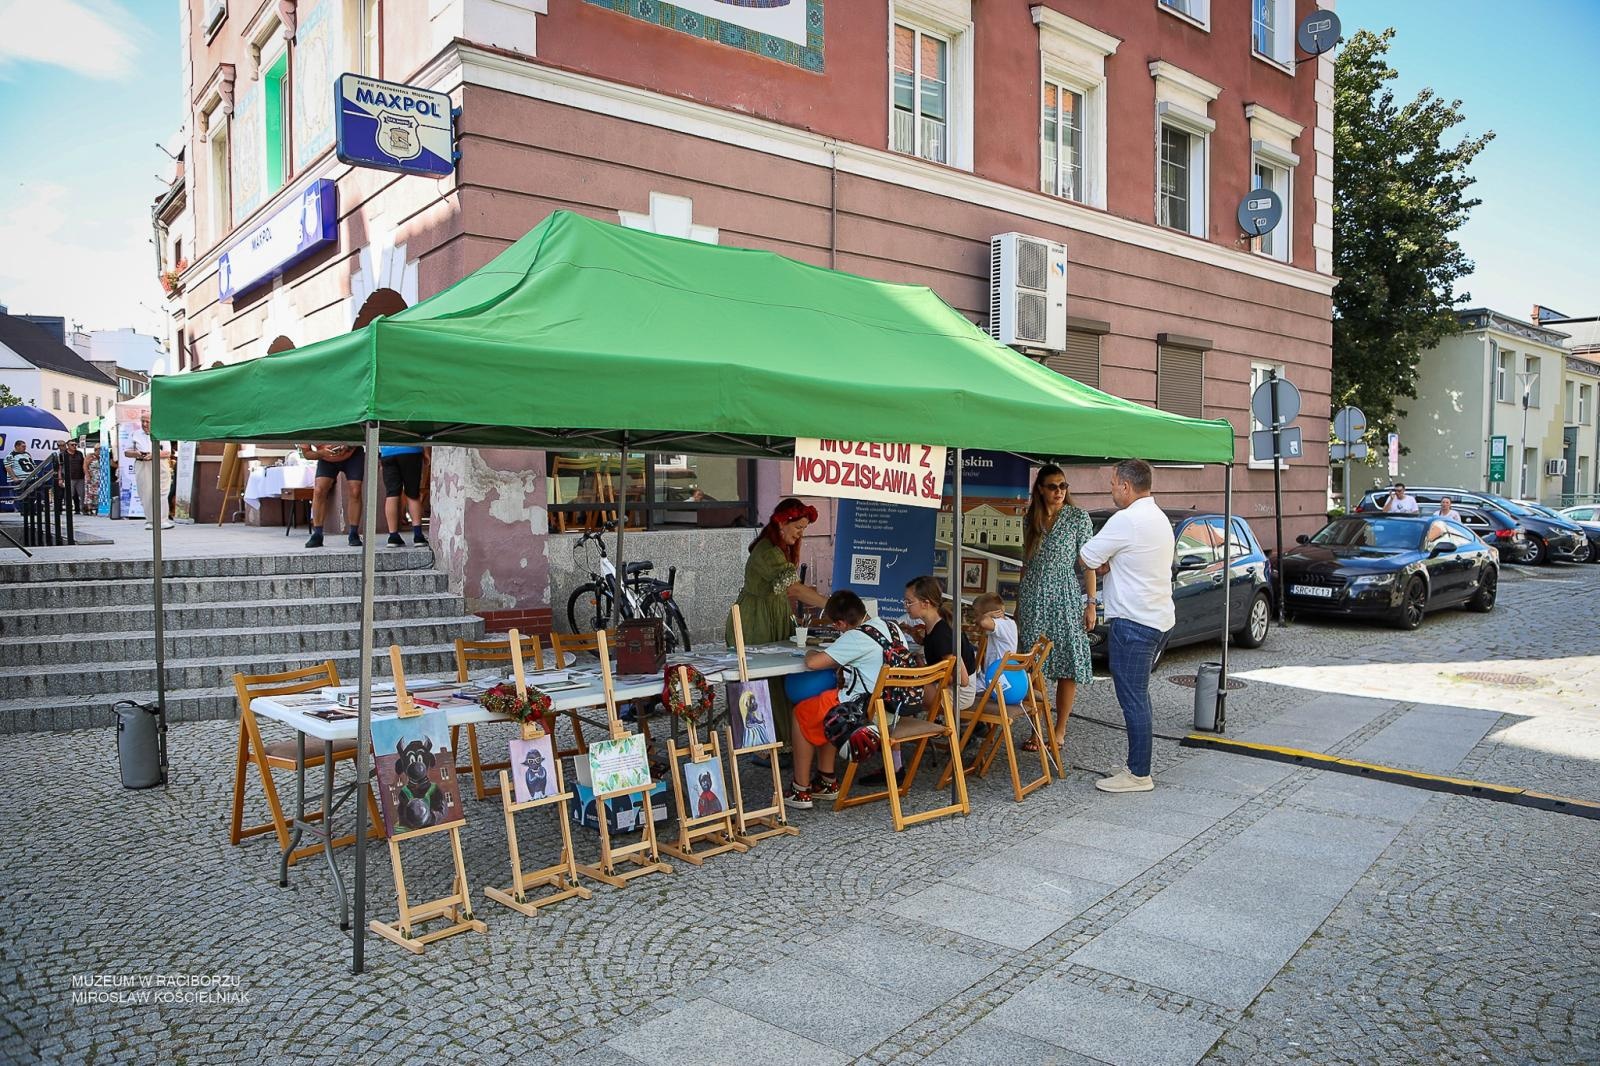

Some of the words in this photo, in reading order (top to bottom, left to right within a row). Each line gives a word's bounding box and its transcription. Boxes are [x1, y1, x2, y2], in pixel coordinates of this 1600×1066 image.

[356, 87, 441, 118] MAXPOL
[820, 439, 911, 464] MUZEUM
[919, 444, 932, 468] Z
[795, 456, 918, 497] WODZISŁAWIA
